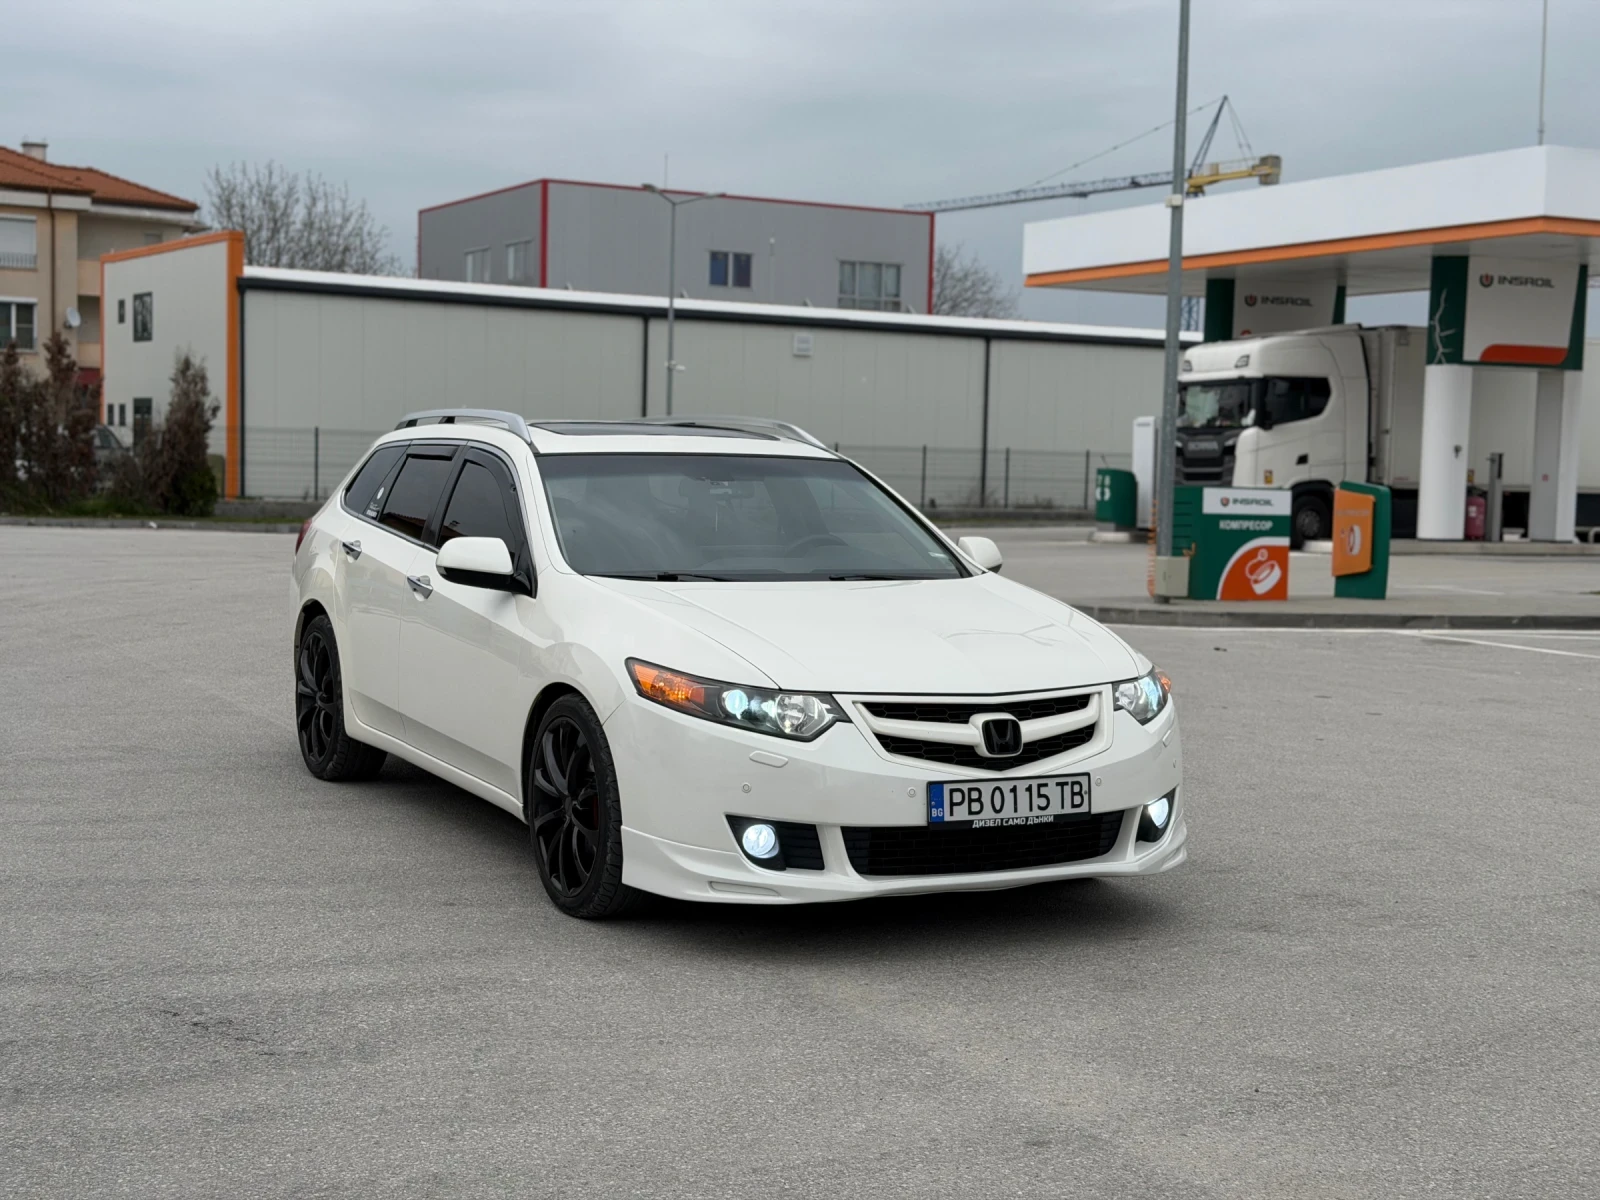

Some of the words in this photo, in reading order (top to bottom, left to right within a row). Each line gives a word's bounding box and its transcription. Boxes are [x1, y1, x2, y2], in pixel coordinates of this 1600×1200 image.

[1219, 520, 1273, 531] КОМПРЕСОР
[931, 808, 944, 817] BG
[972, 819, 1001, 829] ДИЗЕЛ
[1003, 817, 1026, 826] САМО
[1027, 814, 1054, 825] ДЪНКИ
